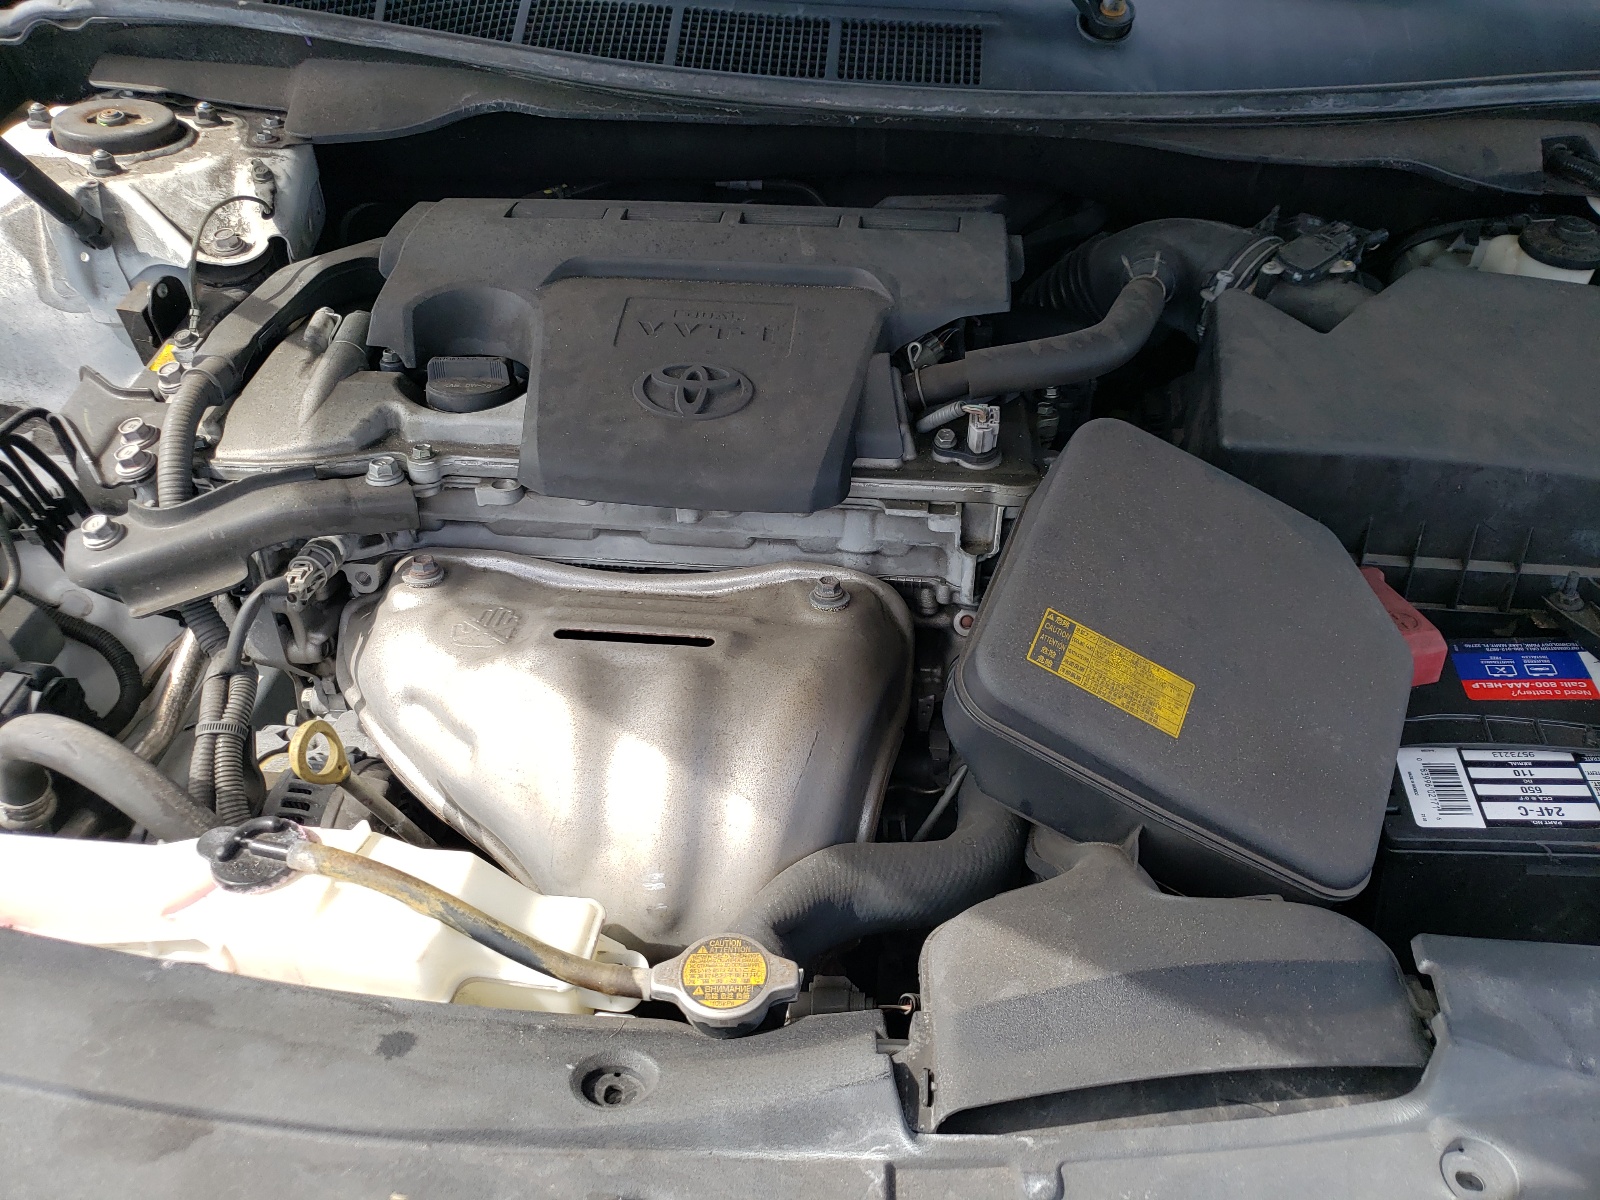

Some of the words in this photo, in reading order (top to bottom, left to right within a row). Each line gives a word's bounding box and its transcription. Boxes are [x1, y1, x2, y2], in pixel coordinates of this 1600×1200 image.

[1045, 622, 1071, 640] CAUTION
[1040, 633, 1066, 651] ATTENTION
[1471, 681, 1557, 689] 800-AAA-HELP
[1511, 688, 1553, 697] battery?
[1513, 769, 1535, 777] 110
[1520, 786, 1543, 794] 650
[1426, 789, 1441, 809] 02171
[1517, 805, 1565, 817] 24F-C
[704, 985, 754, 993] ВНИМАНИЕ!
